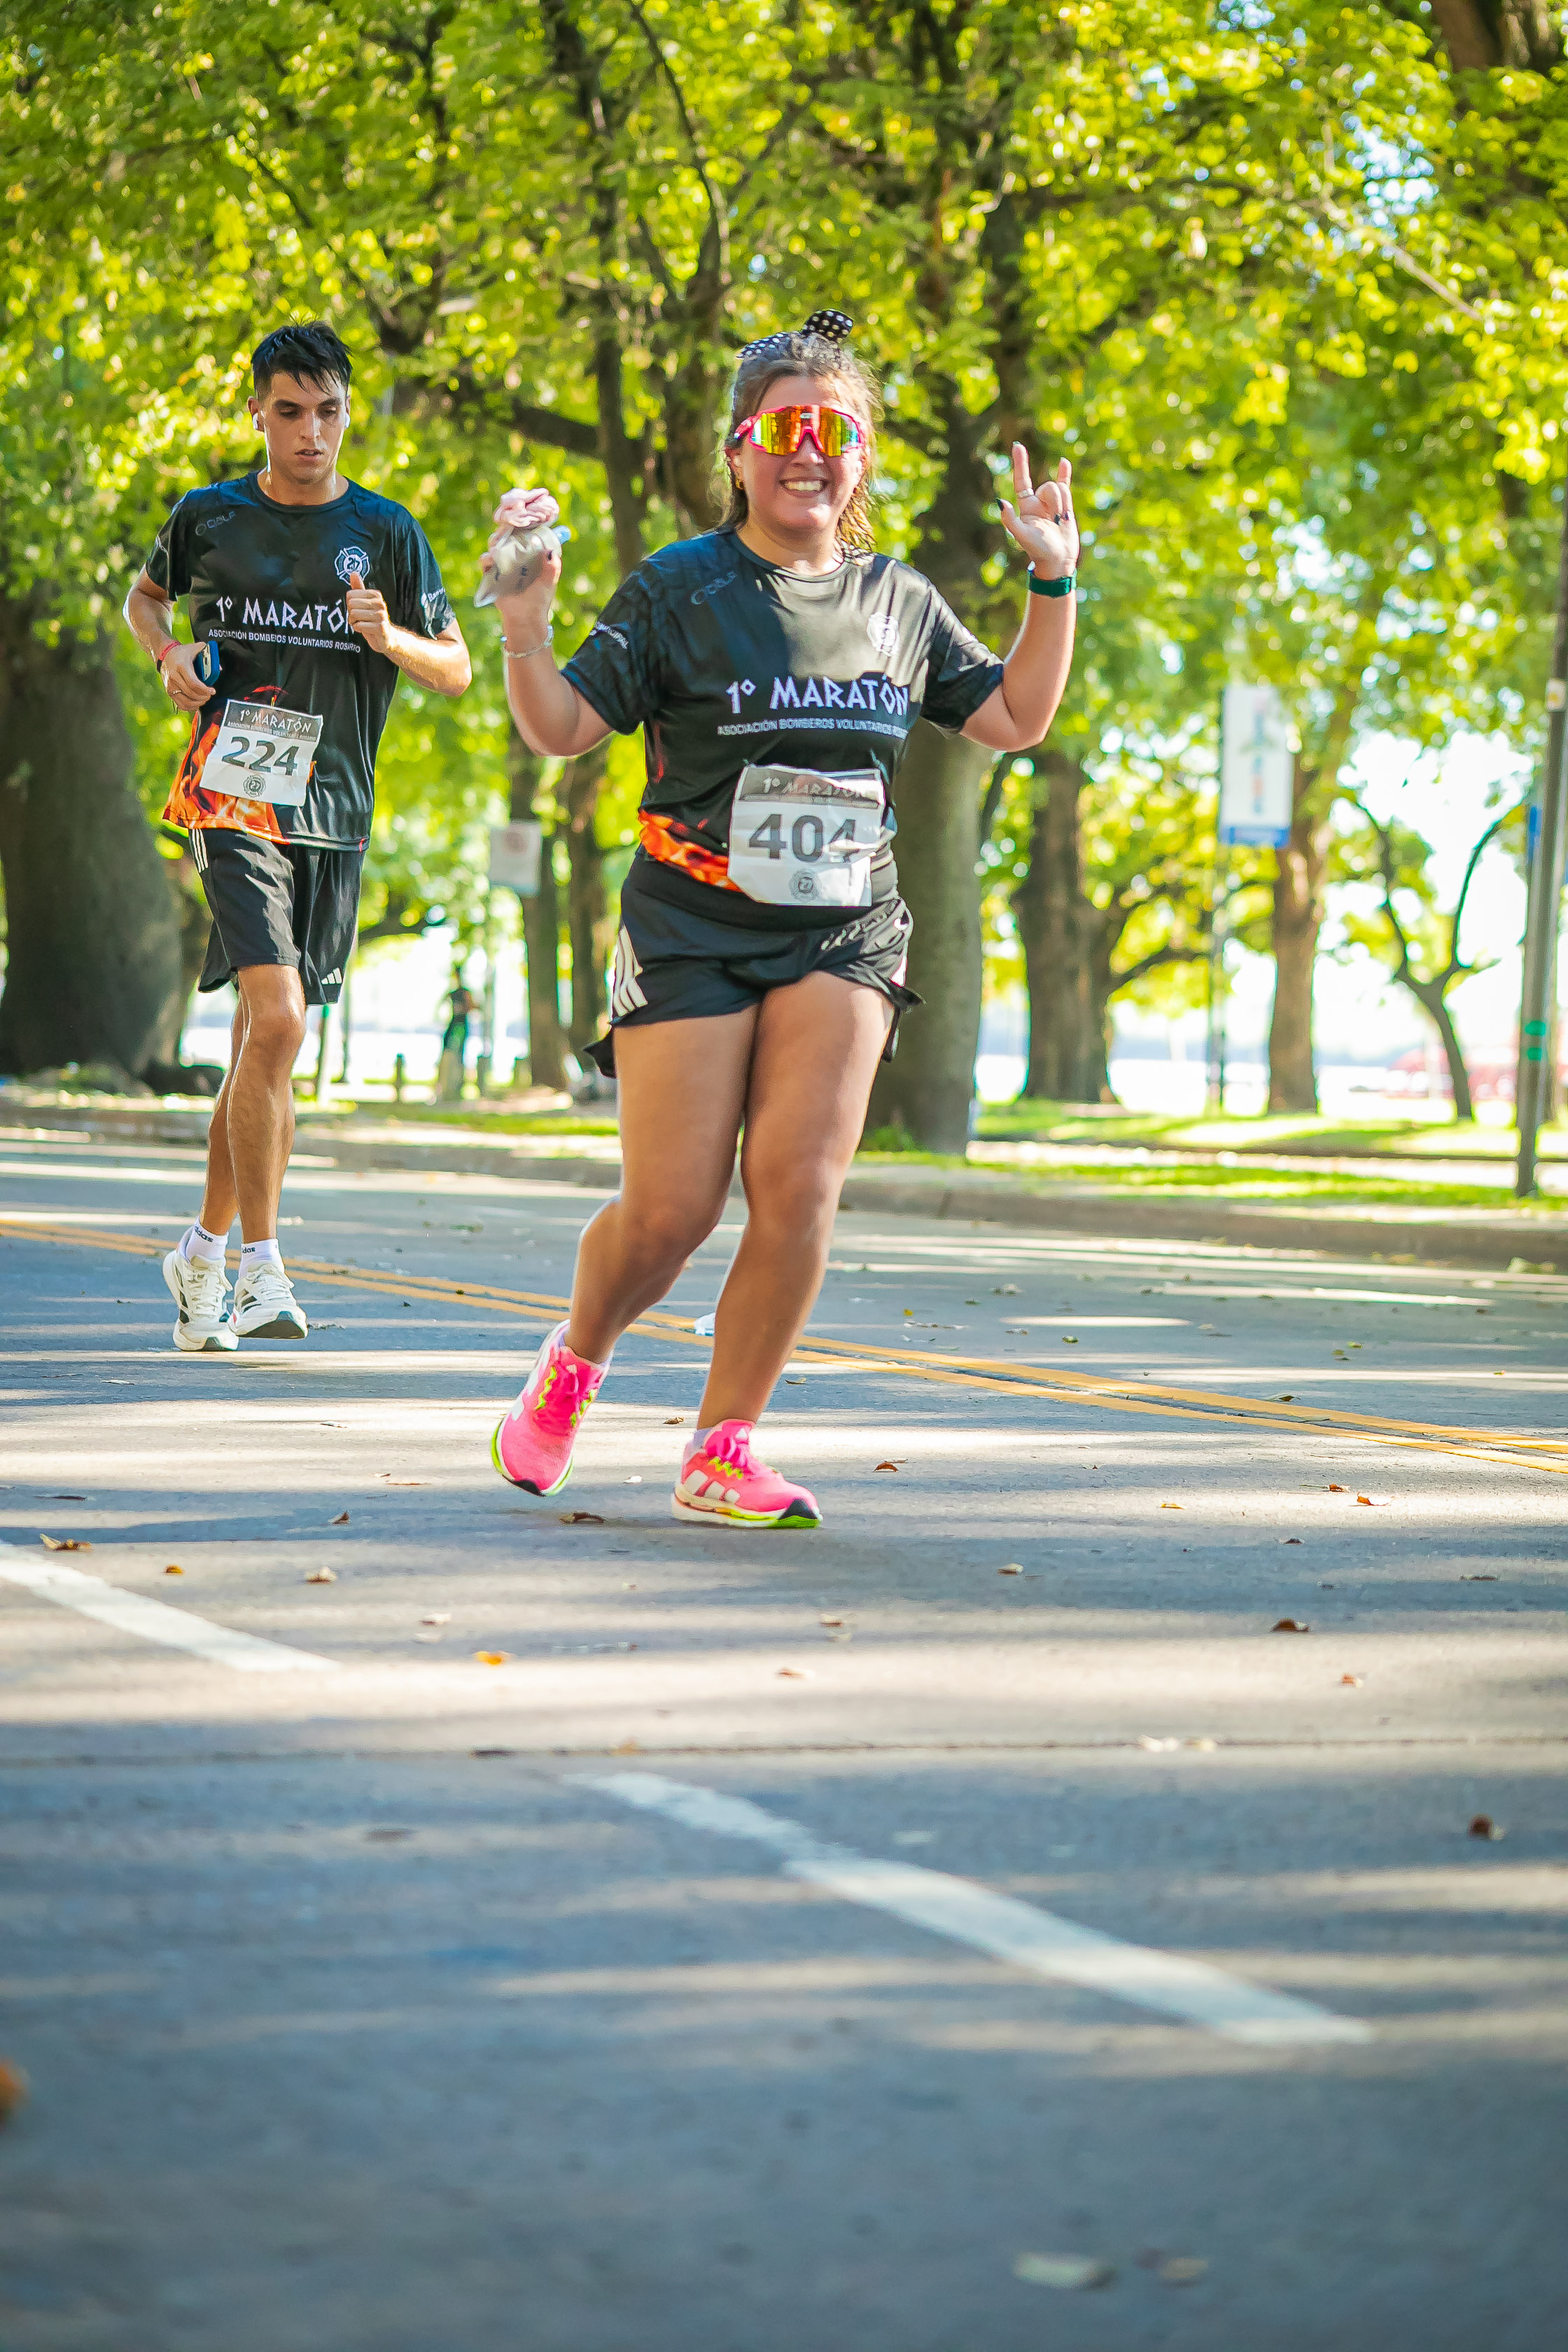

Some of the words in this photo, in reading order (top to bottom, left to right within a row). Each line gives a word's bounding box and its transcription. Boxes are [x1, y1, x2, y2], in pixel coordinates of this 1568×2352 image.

[288, 636, 333, 649] VOLUNTARIOS
[335, 641, 361, 653] ROSARIO
[770, 674, 909, 716] MARATÓN
[251, 710, 312, 733] MARATÓN
[222, 736, 300, 776] 224
[748, 813, 860, 863] 404
